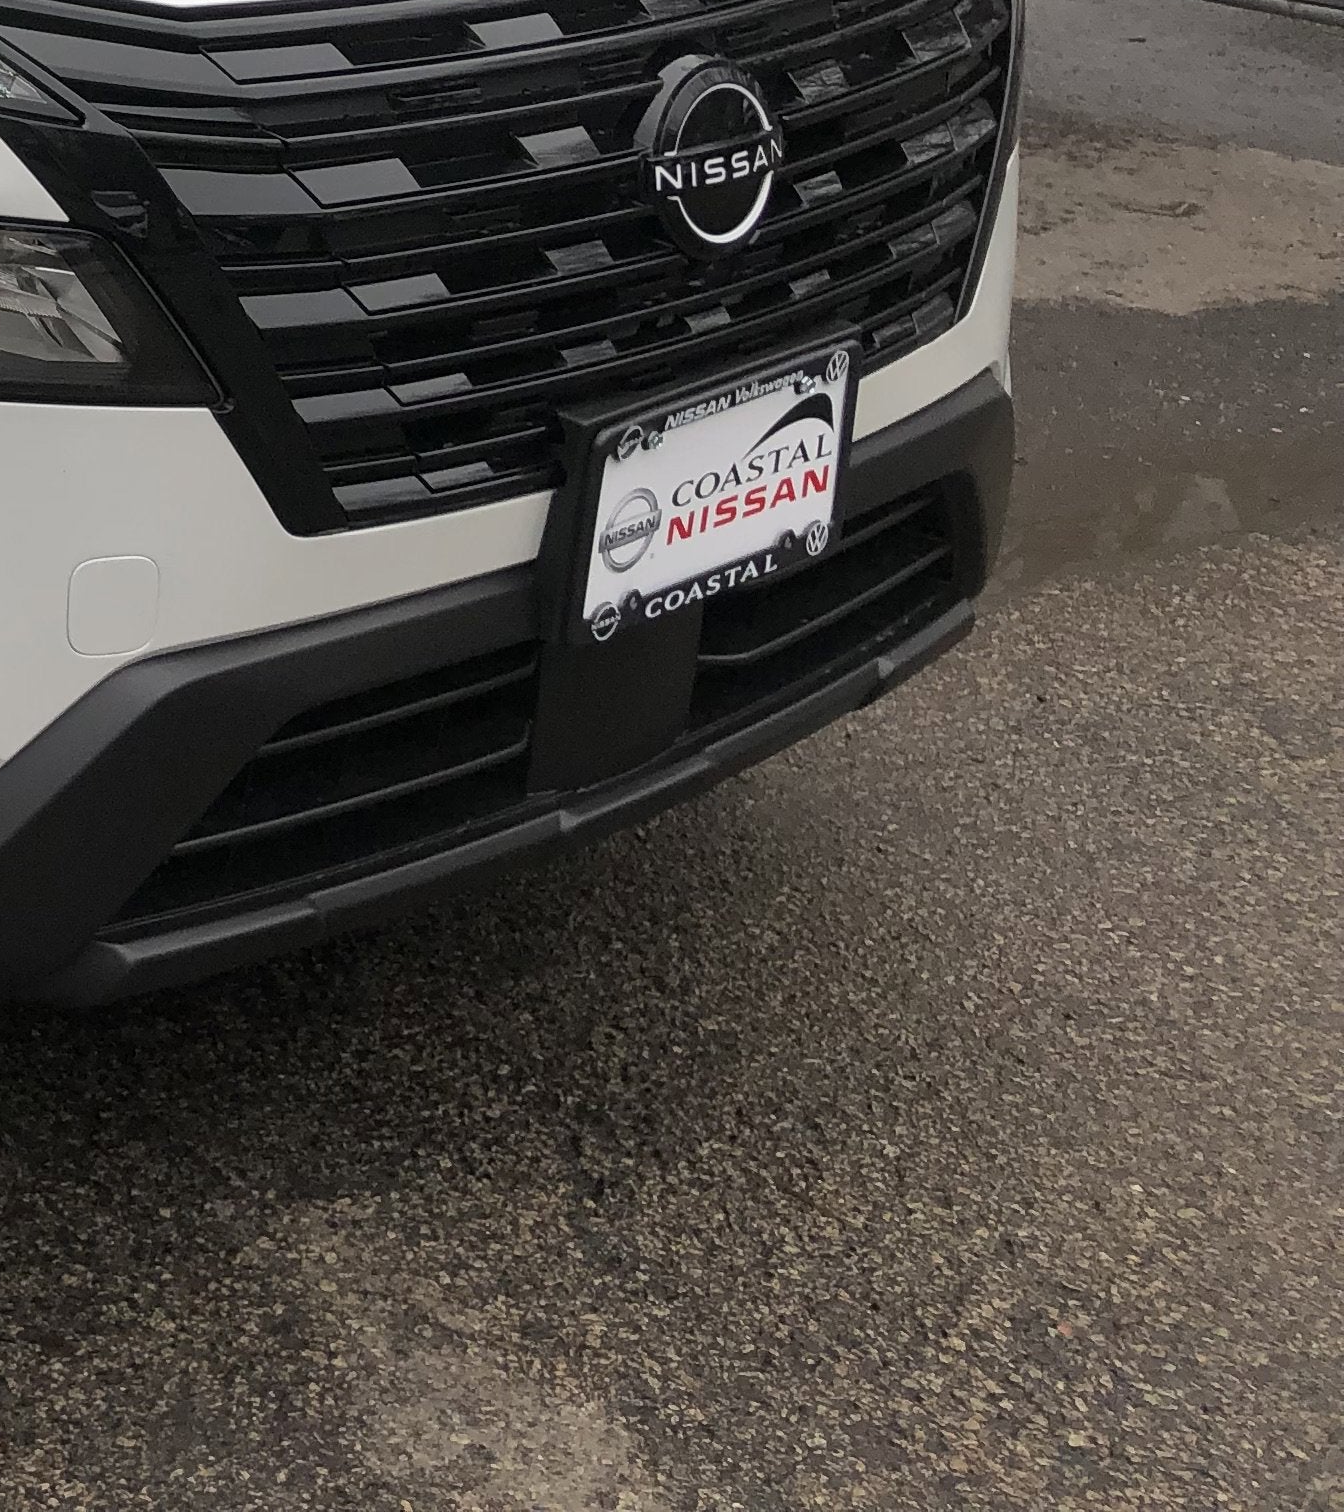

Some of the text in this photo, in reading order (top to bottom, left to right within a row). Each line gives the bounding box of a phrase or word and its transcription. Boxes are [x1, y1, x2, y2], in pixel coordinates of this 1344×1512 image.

[655, 138, 782, 191] NISSAN
[664, 394, 730, 430] NISSAN
[671, 433, 832, 507] COASTAL
[604, 516, 656, 545] NISSAN
[666, 464, 829, 545] NISSAN
[645, 554, 778, 619] COASTAL
